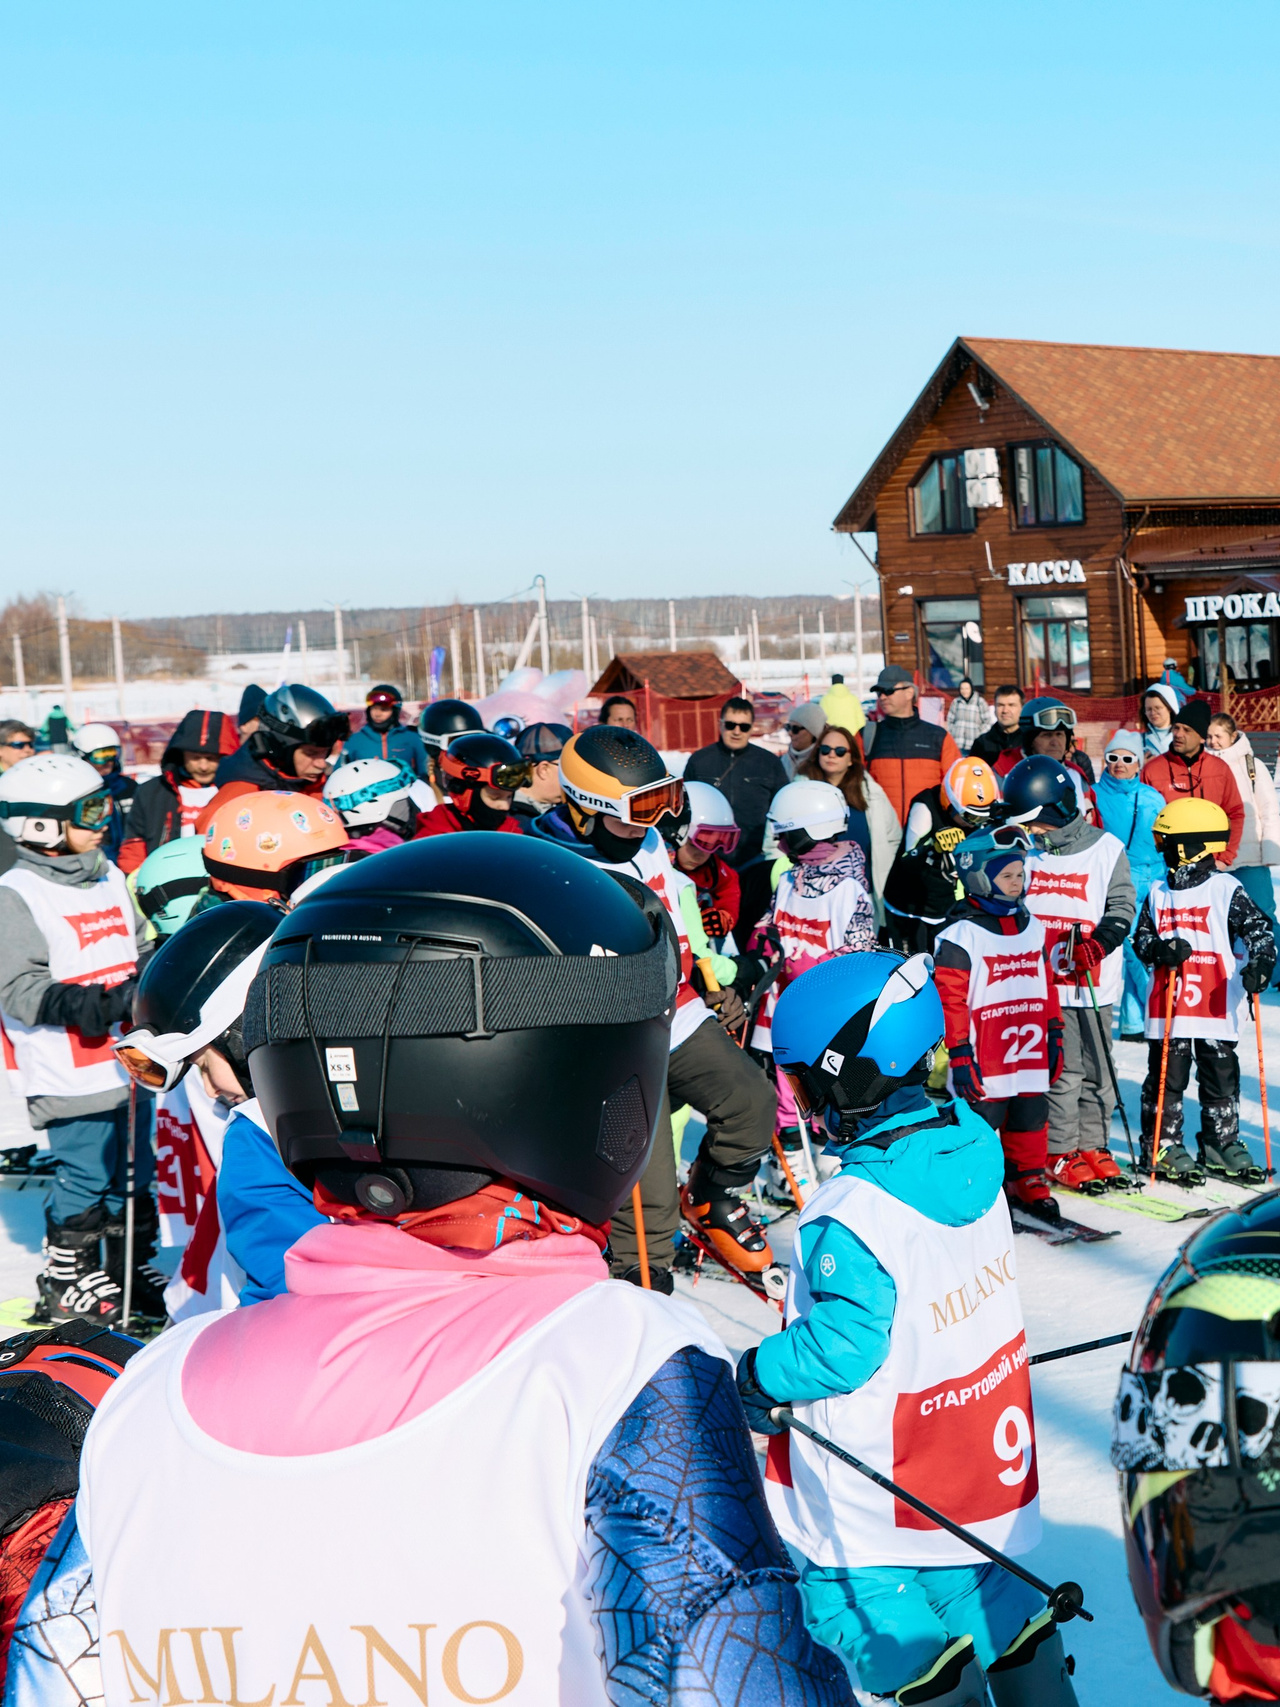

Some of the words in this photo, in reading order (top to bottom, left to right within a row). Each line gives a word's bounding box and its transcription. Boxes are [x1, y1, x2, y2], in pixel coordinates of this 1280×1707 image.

[1007, 560, 1087, 586] КАССА
[563, 785, 619, 812] ALPINA
[1031, 877, 1059, 890] Альфа
[1060, 879, 1083, 890] Банк
[801, 923, 824, 938] Банк
[1182, 912, 1204, 923] Банк
[993, 960, 1020, 973] Альфа
[1189, 955, 1217, 965] НОМЕР
[1001, 1023, 1043, 1064] 22
[920, 1353, 1013, 1417] СТАРТОВЫЙ
[993, 1405, 1033, 1487] 9
[107, 1620, 524, 1707] MILANO
